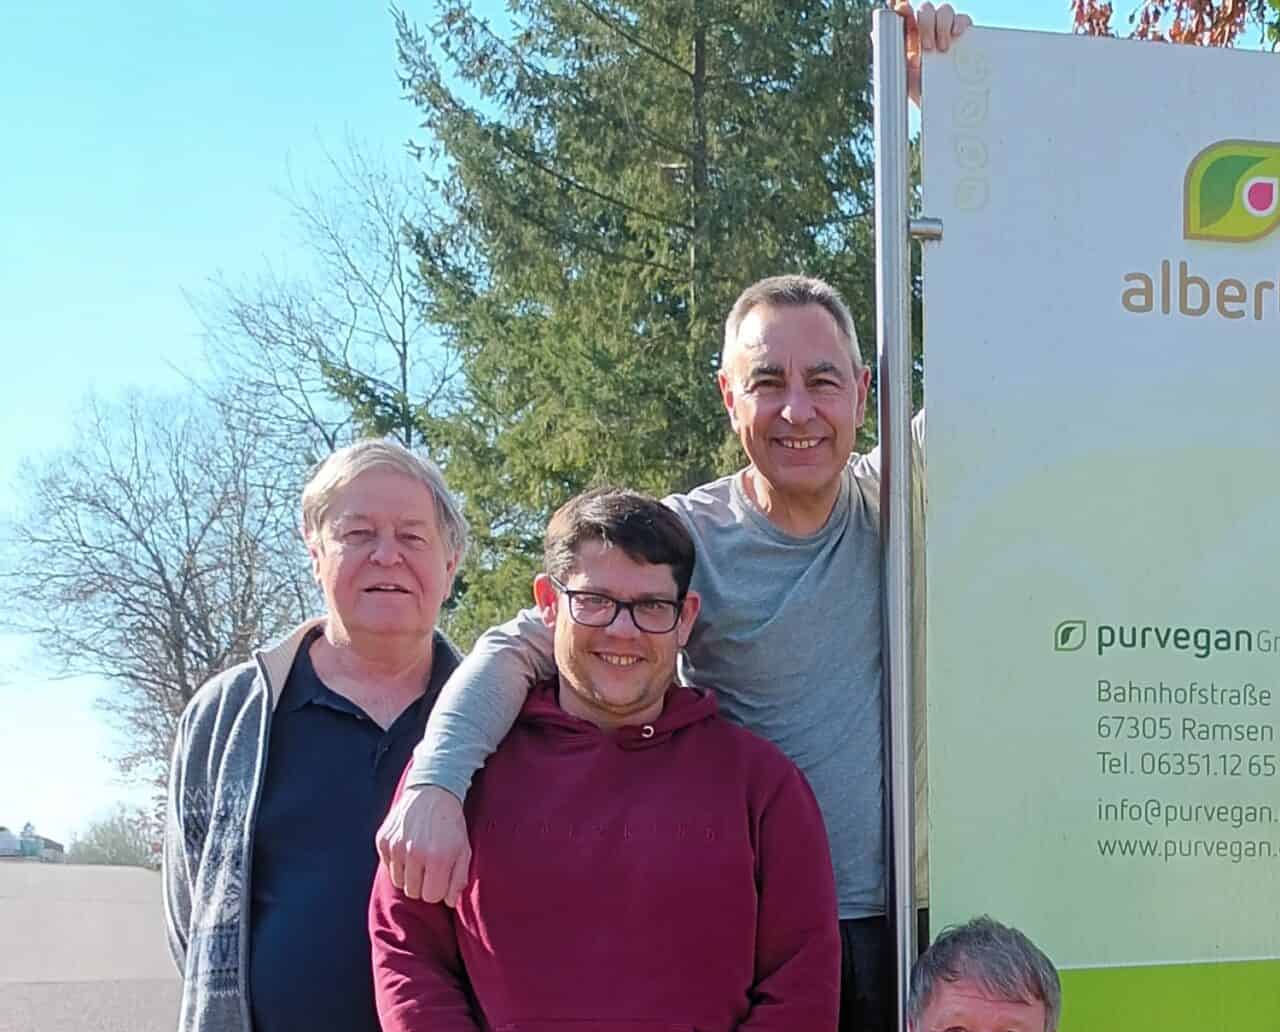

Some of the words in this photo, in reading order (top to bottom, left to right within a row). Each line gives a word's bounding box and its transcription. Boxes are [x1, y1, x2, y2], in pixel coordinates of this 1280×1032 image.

[1097, 624, 1253, 658] purvegan
[1097, 680, 1271, 707] Bahnhofstraße
[1097, 716, 1173, 740] 67305
[1181, 718, 1274, 742] Ramsen
[1097, 751, 1135, 775] Tel.
